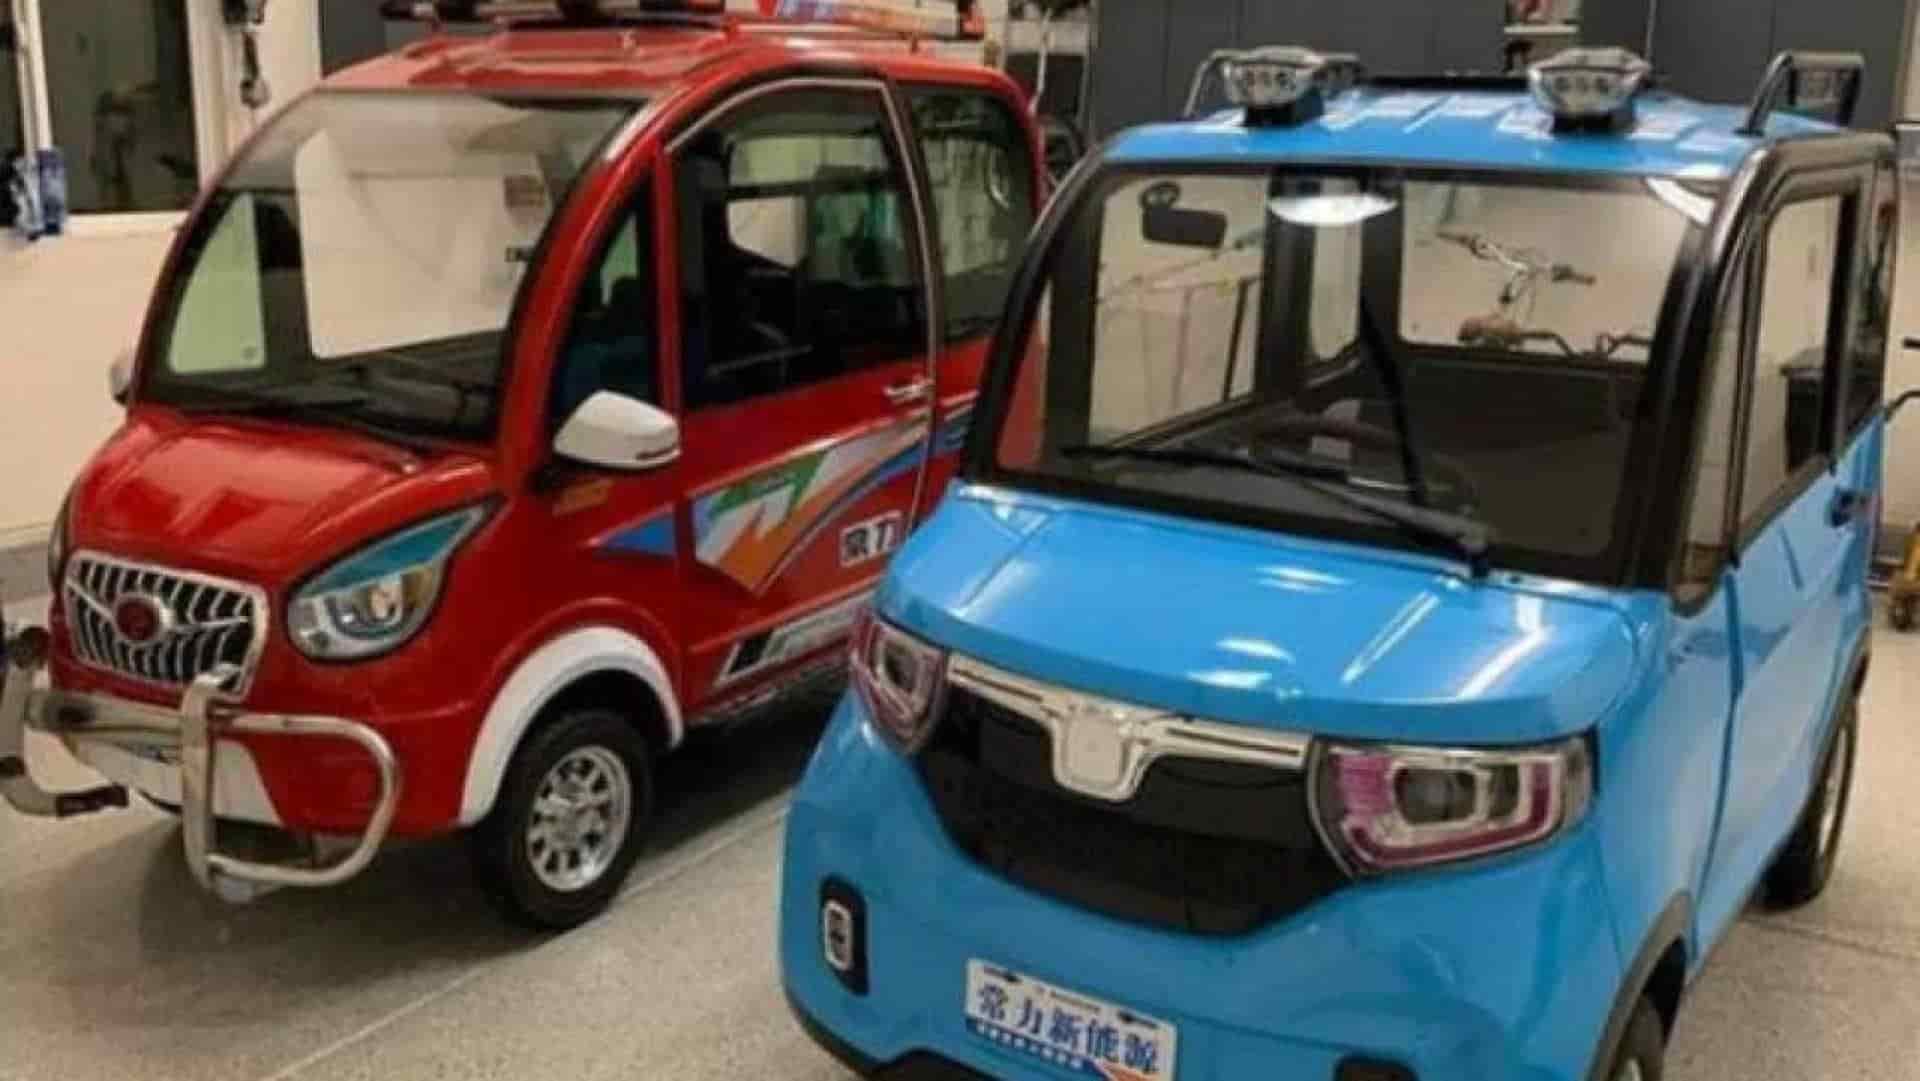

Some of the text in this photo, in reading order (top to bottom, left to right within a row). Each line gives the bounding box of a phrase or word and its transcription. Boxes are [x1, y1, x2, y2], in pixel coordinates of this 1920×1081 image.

[977, 983, 1158, 1074] 常力新能源
